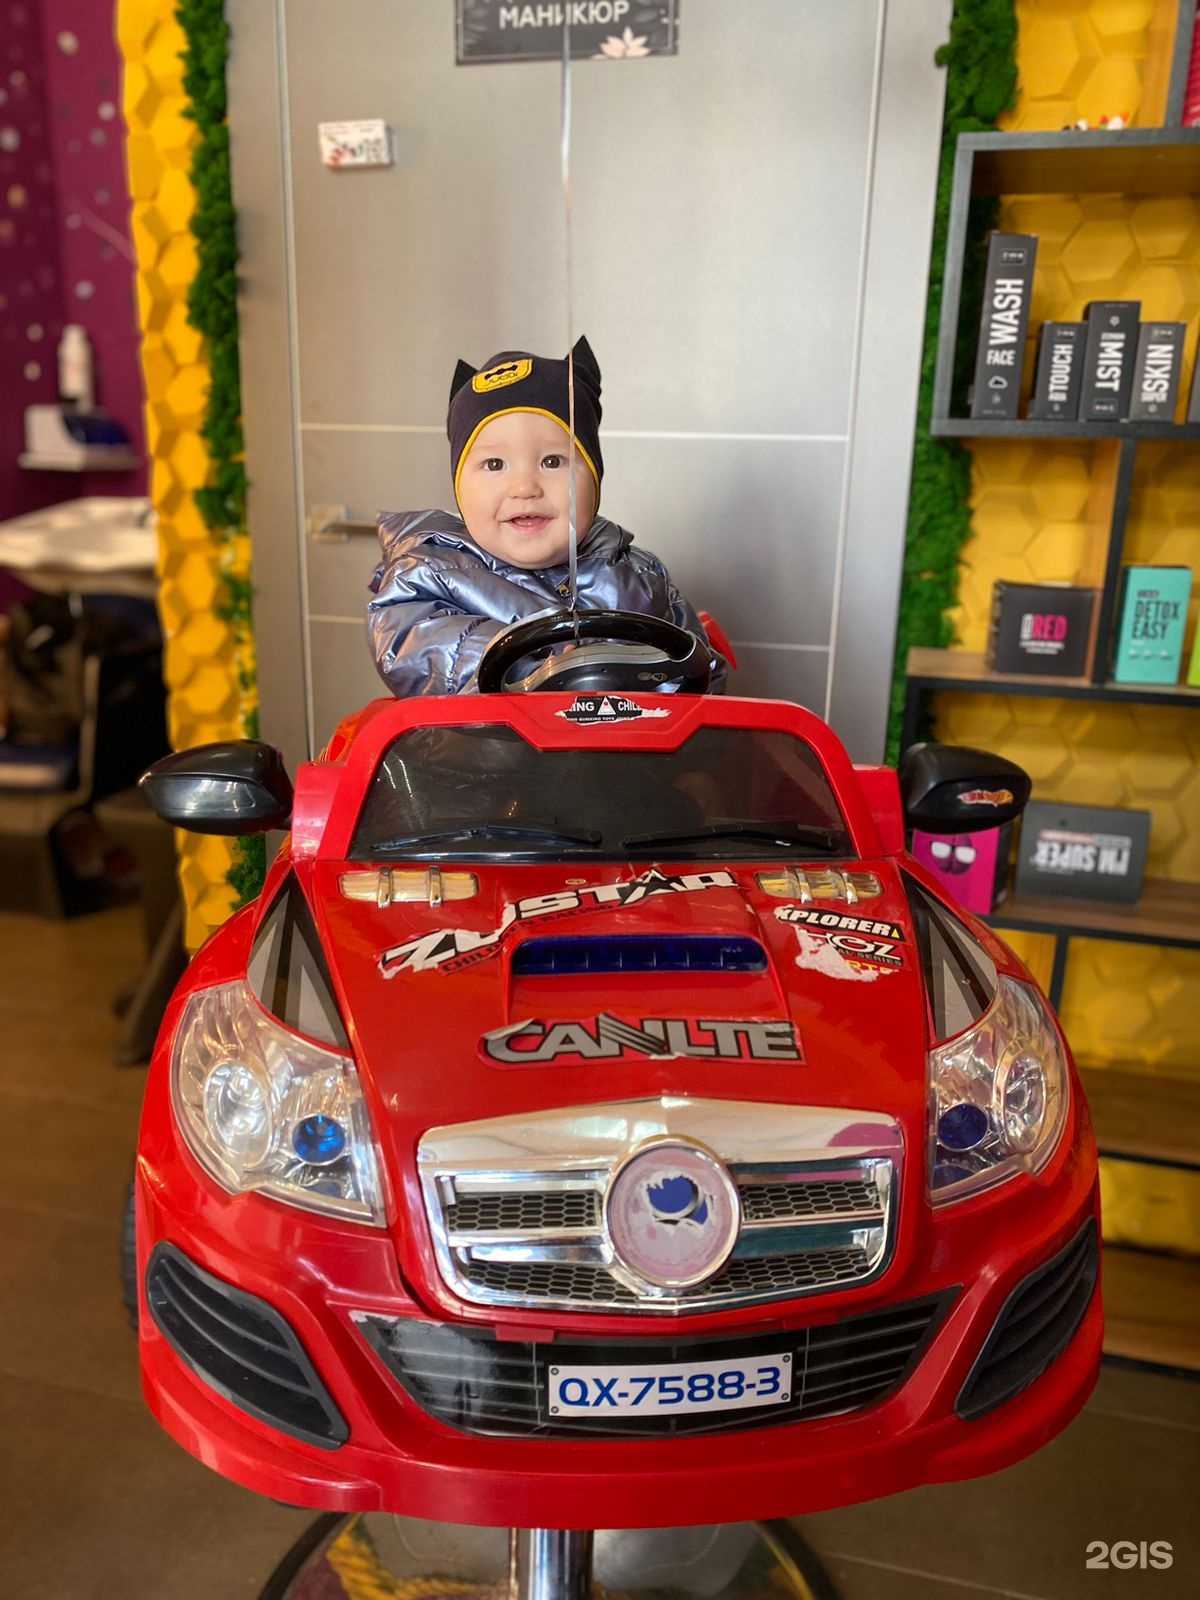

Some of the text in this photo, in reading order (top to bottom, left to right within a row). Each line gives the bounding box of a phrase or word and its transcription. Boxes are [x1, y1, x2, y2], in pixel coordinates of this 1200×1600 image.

[499, 1, 630, 29] МАНИКЮР
[989, 278, 1025, 346] WASH
[1050, 344, 1074, 392] TOUCH
[1095, 342, 1125, 392] MIST
[1142, 344, 1174, 392] SKIN
[1132, 622, 1170, 640] EASY
[1135, 601, 1181, 619] DETOX
[558, 1366, 781, 1408] QX-7588-3
